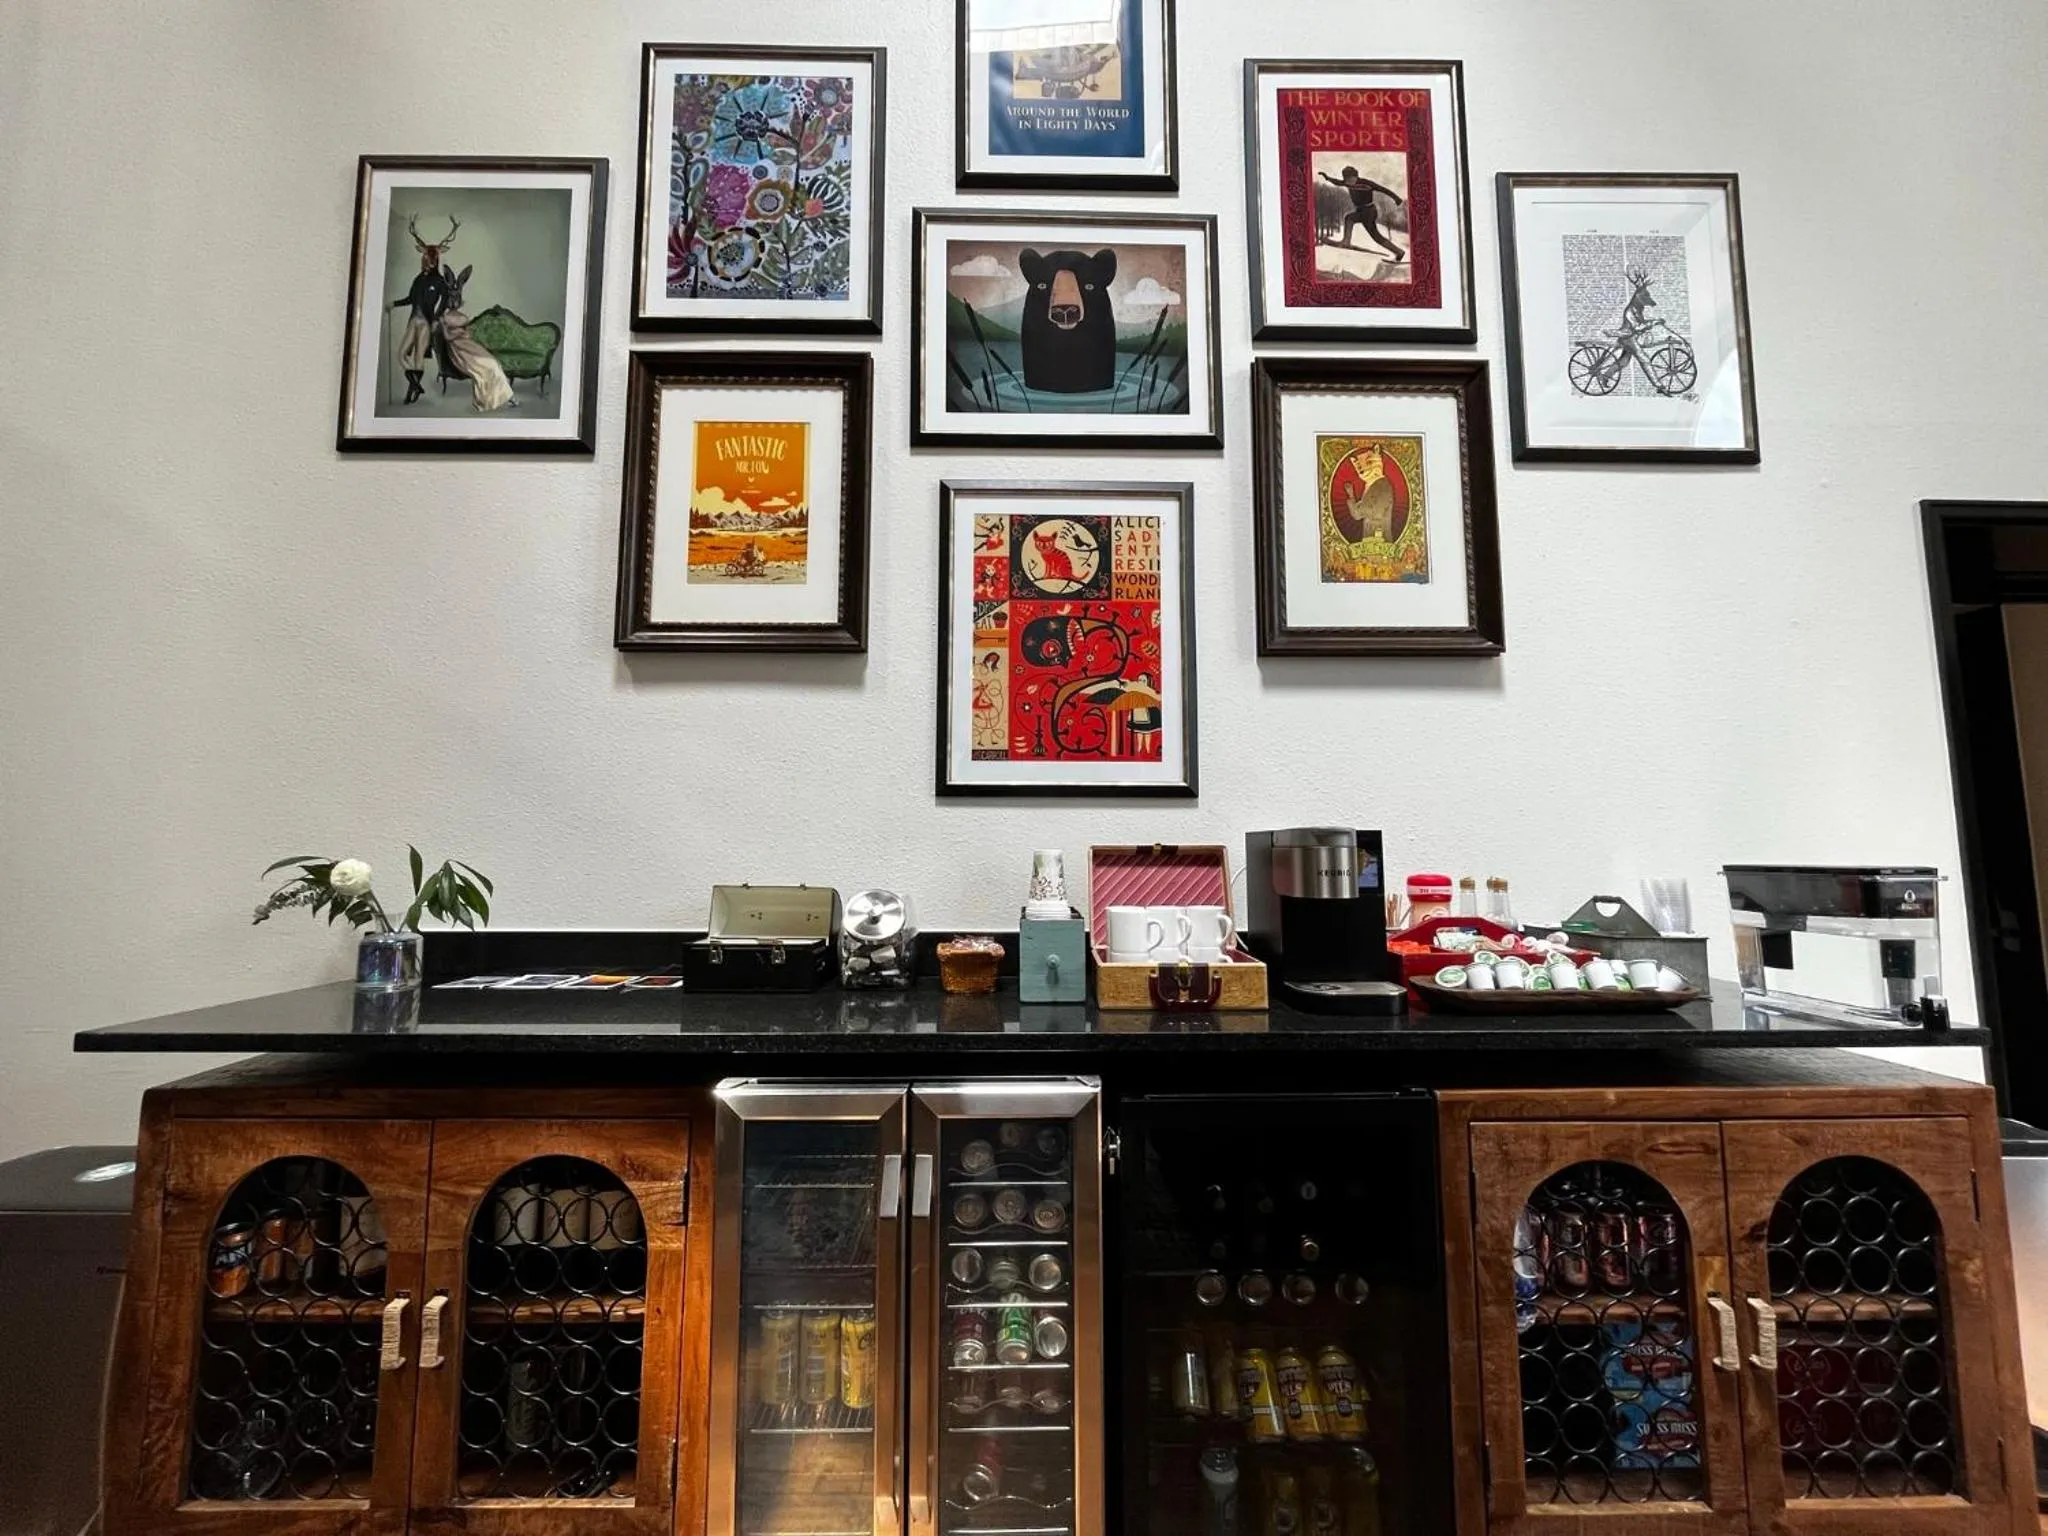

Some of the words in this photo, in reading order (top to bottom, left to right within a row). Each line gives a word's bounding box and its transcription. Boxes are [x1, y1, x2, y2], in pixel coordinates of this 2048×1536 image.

[1286, 91, 1329, 106] THE
[1335, 91, 1395, 107] BOOK
[1398, 92, 1427, 107] OF
[1310, 110, 1405, 127] WINTER
[1310, 130, 1404, 147] SPORTS
[715, 435, 788, 461] FANTASTIC
